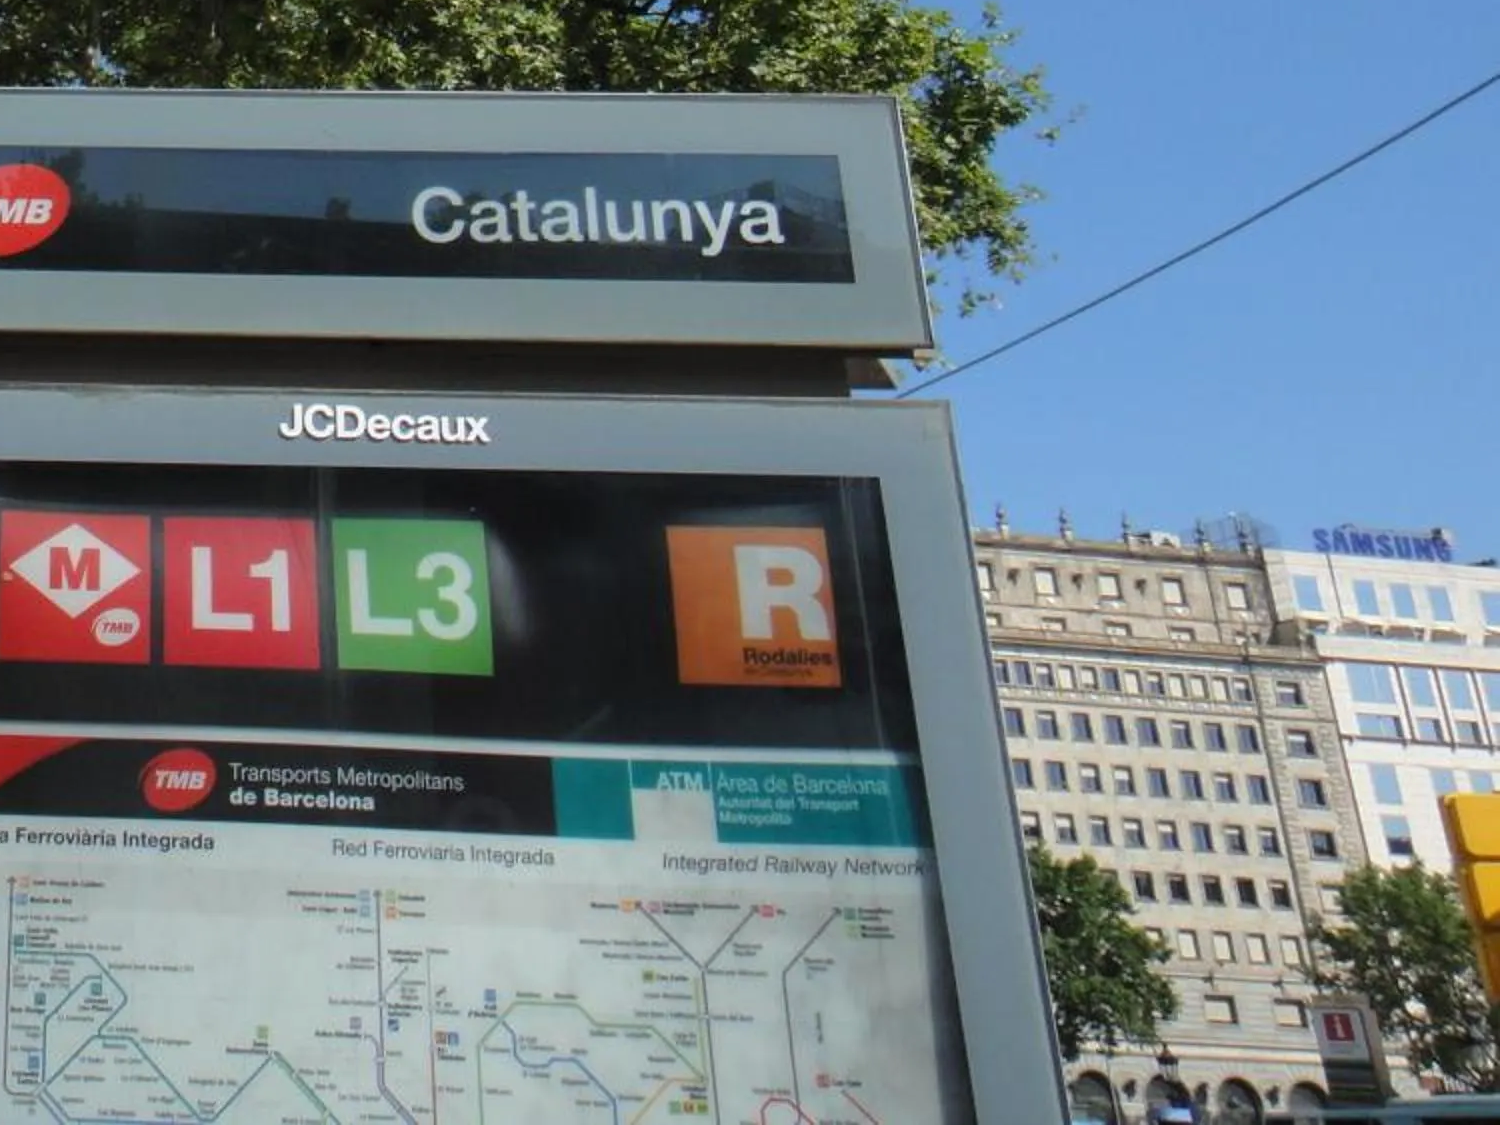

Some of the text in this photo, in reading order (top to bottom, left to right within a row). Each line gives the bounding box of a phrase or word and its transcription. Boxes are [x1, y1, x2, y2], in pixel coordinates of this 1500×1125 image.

[411, 185, 785, 257] Catalunya
[279, 403, 491, 444] JCDecaux
[1312, 528, 1452, 563] SAMSUNG
[49, 546, 101, 591] M
[189, 544, 292, 633] L1
[345, 547, 479, 641] L3
[733, 544, 831, 641] R
[101, 622, 134, 634] TMB
[742, 646, 833, 666] Rodalies
[155, 770, 208, 790] TMB
[229, 763, 465, 792] Transports Metropolitans
[656, 771, 703, 792] ATM
[763, 774, 789, 794] de
[793, 774, 888, 796] Barcelona
[229, 788, 375, 812] de Barcelona
[123, 833, 215, 853] Integrada
[331, 838, 556, 869] Red Ferroviaria Integrada
[663, 853, 759, 874] Integrated
[764, 856, 839, 879] Railway
